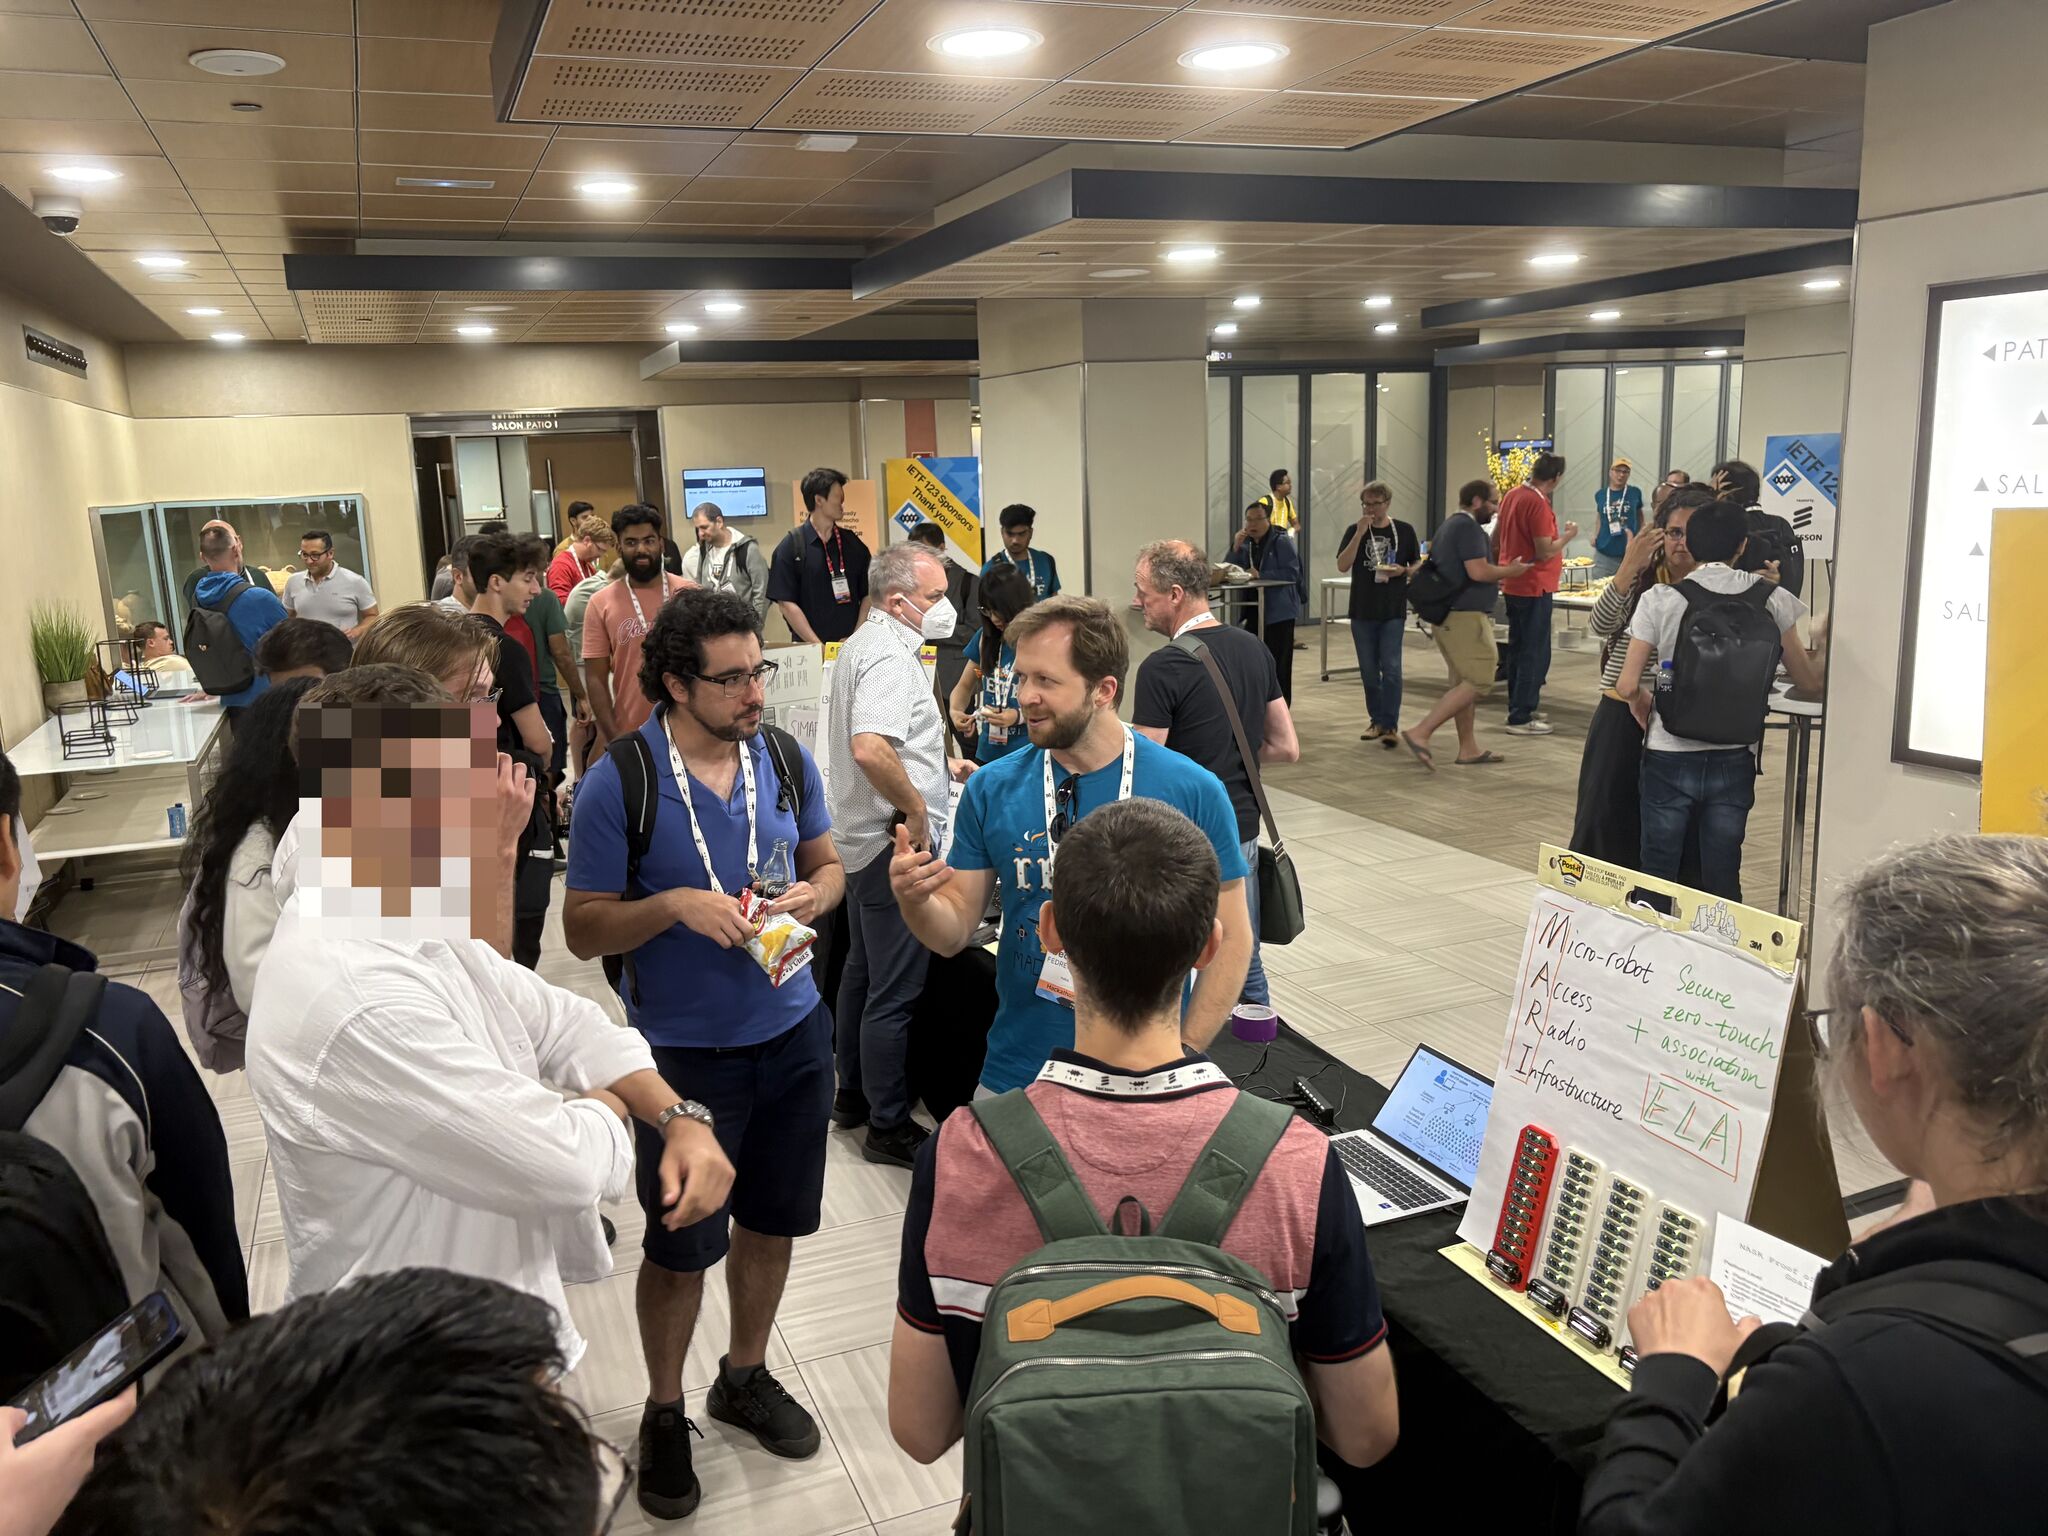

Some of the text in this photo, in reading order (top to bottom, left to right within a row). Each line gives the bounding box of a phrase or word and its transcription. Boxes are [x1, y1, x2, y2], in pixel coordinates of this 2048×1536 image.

[491, 421, 523, 430] SALON
[526, 420, 552, 429] PATIO
[1785, 440, 1824, 472] IETF
[722, 479, 742, 487] Foyer
[906, 464, 974, 531] IETF 123 Sponsors
[1997, 474, 2044, 494] SAL
[912, 486, 954, 529] Thank you!
[1943, 600, 1987, 622] SAL
[1562, 860, 1581, 872] Post-it
[1539, 911, 1655, 984] Micro-robot
[1749, 940, 1763, 951] 3M
[1530, 960, 1593, 1013] Access
[1676, 963, 1736, 1010] Secure
[1524, 998, 1587, 1051] Radio
[1663, 1005, 1779, 1060] zero-touch
[1660, 1035, 1768, 1090] association
[1685, 1068, 1722, 1093] with
[1643, 1081, 1729, 1165] ELA
